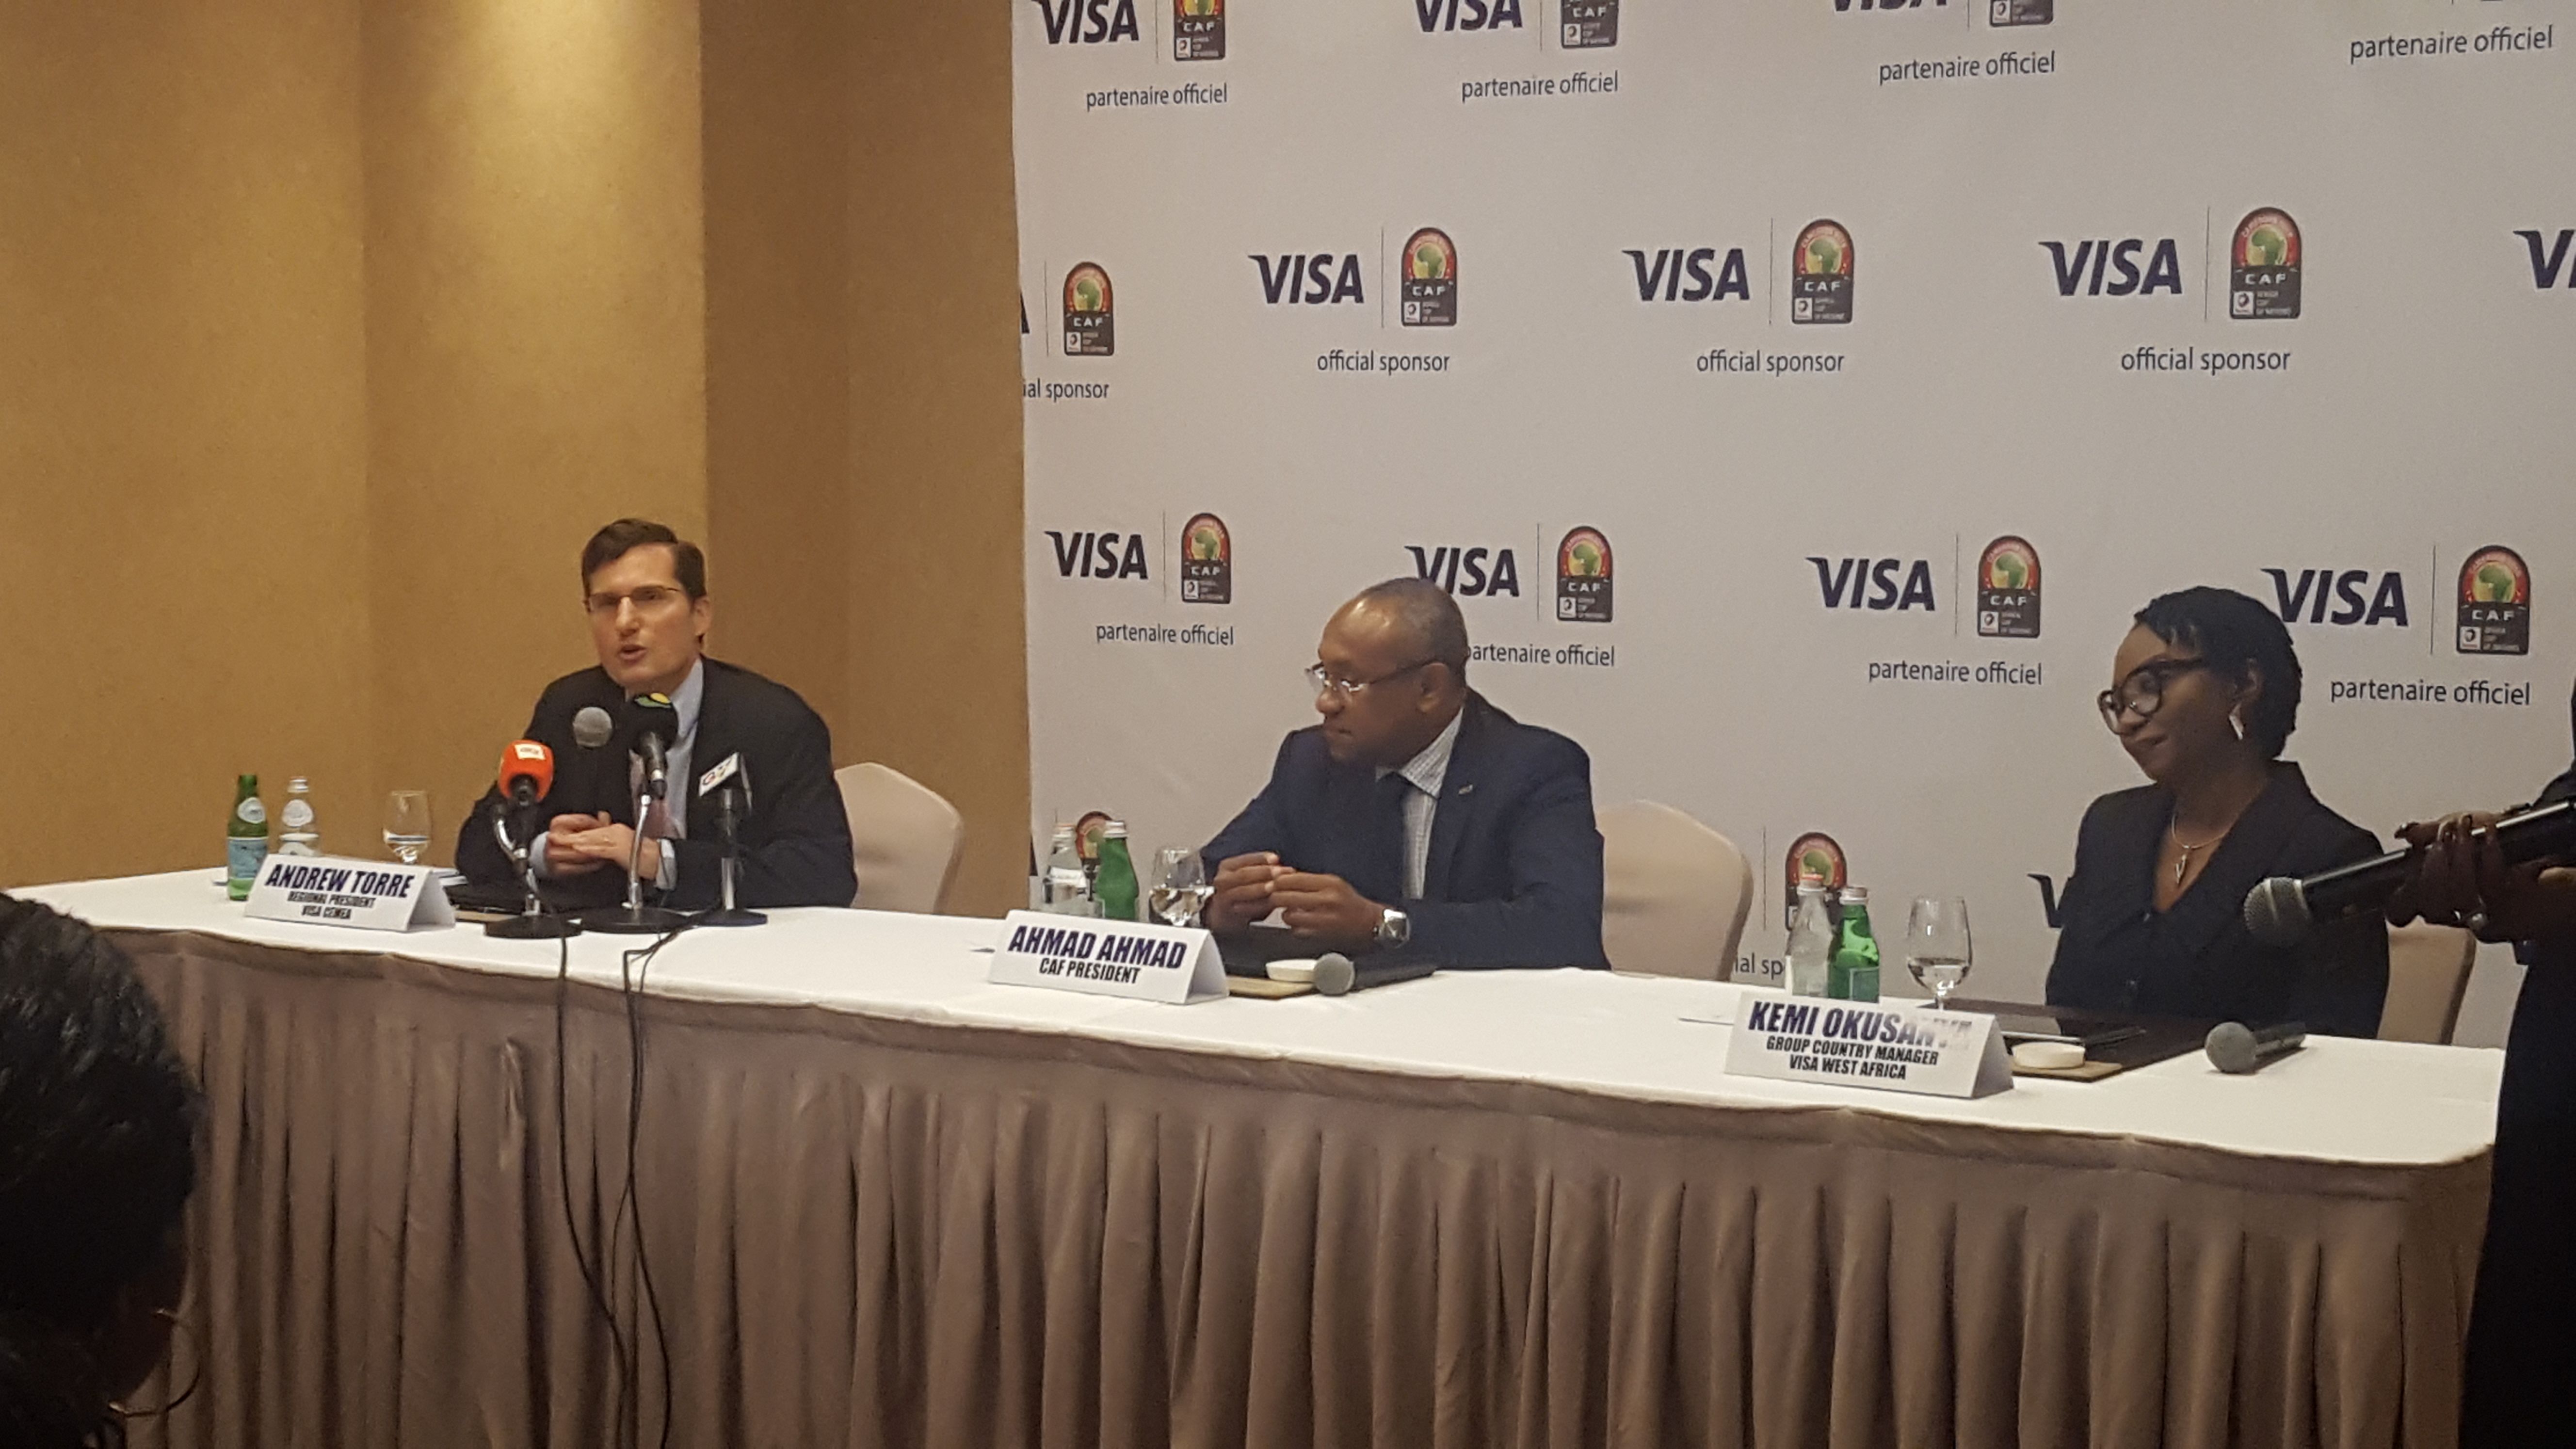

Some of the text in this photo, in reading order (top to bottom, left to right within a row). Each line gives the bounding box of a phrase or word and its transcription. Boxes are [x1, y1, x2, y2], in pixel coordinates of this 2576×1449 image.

[1031, 0, 1139, 44] VISA
[1573, 6, 1606, 17] CAF
[2351, 24, 2553, 64] partenaire officiel
[1880, 50, 2055, 86] partenaire officiel
[1087, 83, 1227, 112] partenaire officiel
[1462, 70, 1618, 103] partenaire officiel
[1248, 254, 1364, 304] VISA
[1622, 248, 1750, 302] VISA
[2038, 239, 2182, 296] VISA
[2245, 273, 2286, 285] CAF
[1412, 286, 1446, 296] CAF
[1804, 281, 1841, 291] CAF
[1073, 317, 1103, 327] CAF
[1317, 350, 1450, 375] official sponsor
[1697, 350, 1845, 377] official sponsor
[2121, 347, 2290, 375] official sponsor
[1046, 383, 1109, 402] sponsor
[1044, 531, 1148, 580] VISA
[1404, 546, 1519, 597] VISA
[1805, 557, 1935, 611] VISA
[1568, 582, 1600, 592] CAF
[1990, 595, 2027, 606] CAF
[2260, 568, 2408, 626] VISA
[2472, 609, 2514, 621] CAF
[1096, 623, 1234, 645] partenaire officiel
[1468, 644, 1614, 666] artenaire officiel
[1869, 660, 2042, 685] partenaire officiel
[2331, 679, 2530, 705] partenaire officiel
[265, 864, 415, 898] ANDREW TORRE
[1008, 925, 1187, 969] AHMAD AHMAD
[1039, 958, 1141, 984] CAF PRESIDENT
[1748, 1001, 1819, 1035] KEMI
[1767, 1035, 1939, 1065] GROUP COUNTRY MANAGER
[1789, 1054, 1907, 1080] VISA WEST AFRICA
